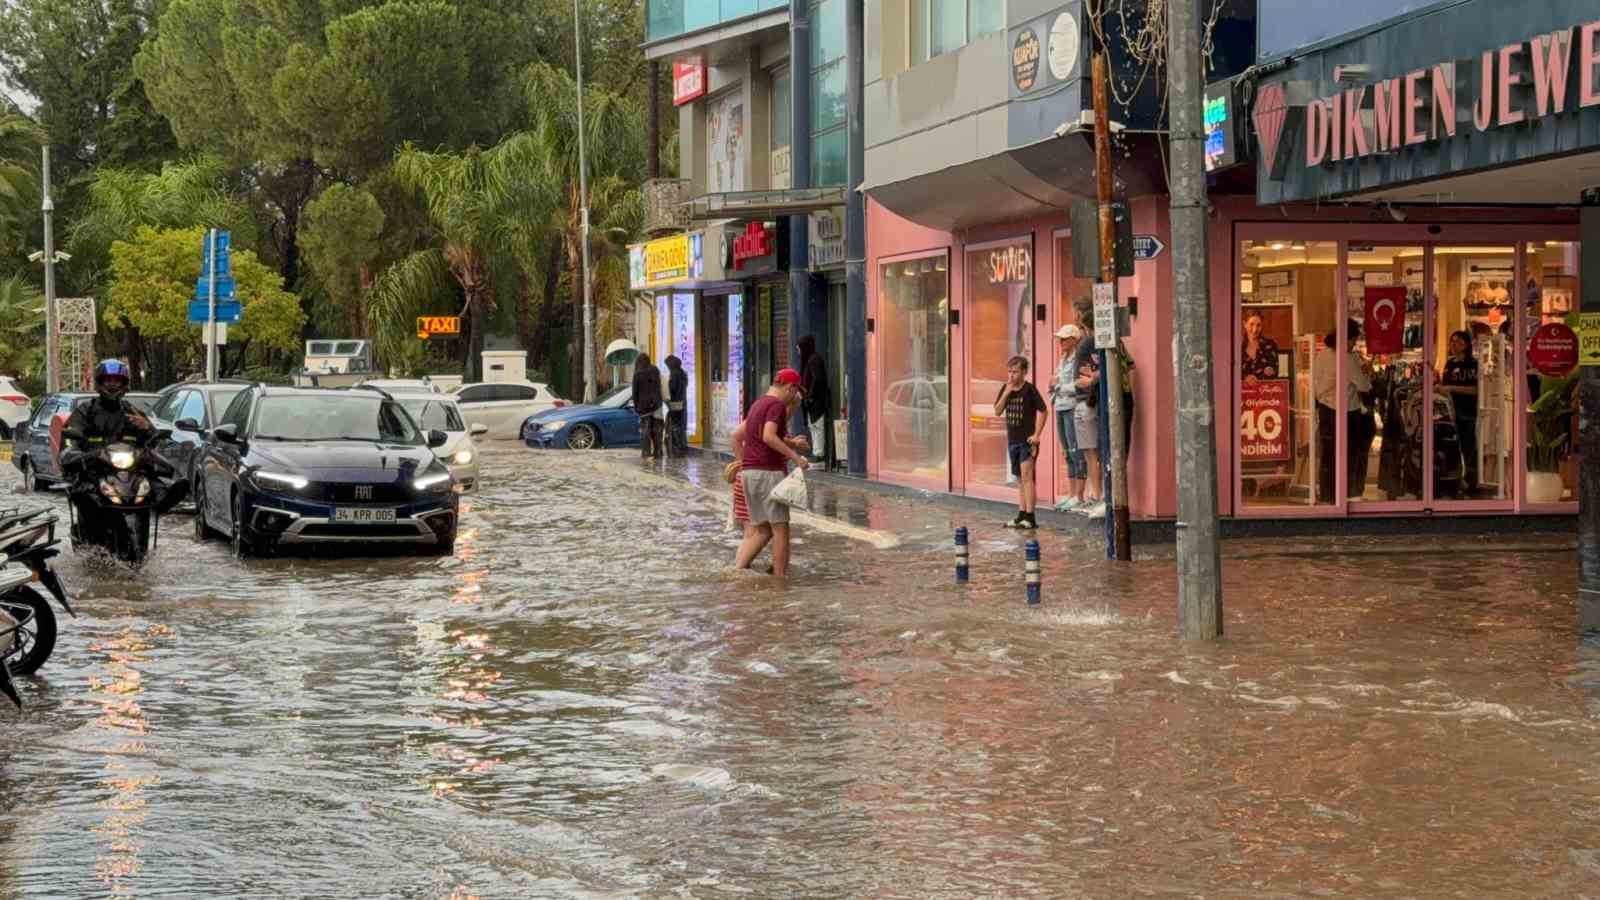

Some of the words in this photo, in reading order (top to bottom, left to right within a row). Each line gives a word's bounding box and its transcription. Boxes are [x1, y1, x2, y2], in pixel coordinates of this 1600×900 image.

[1305, 64, 1456, 168] DİKMEN
[420, 317, 455, 332] TAXI
[354, 485, 373, 500] FIAT
[336, 510, 348, 520] 34
[376, 510, 392, 520] 005
